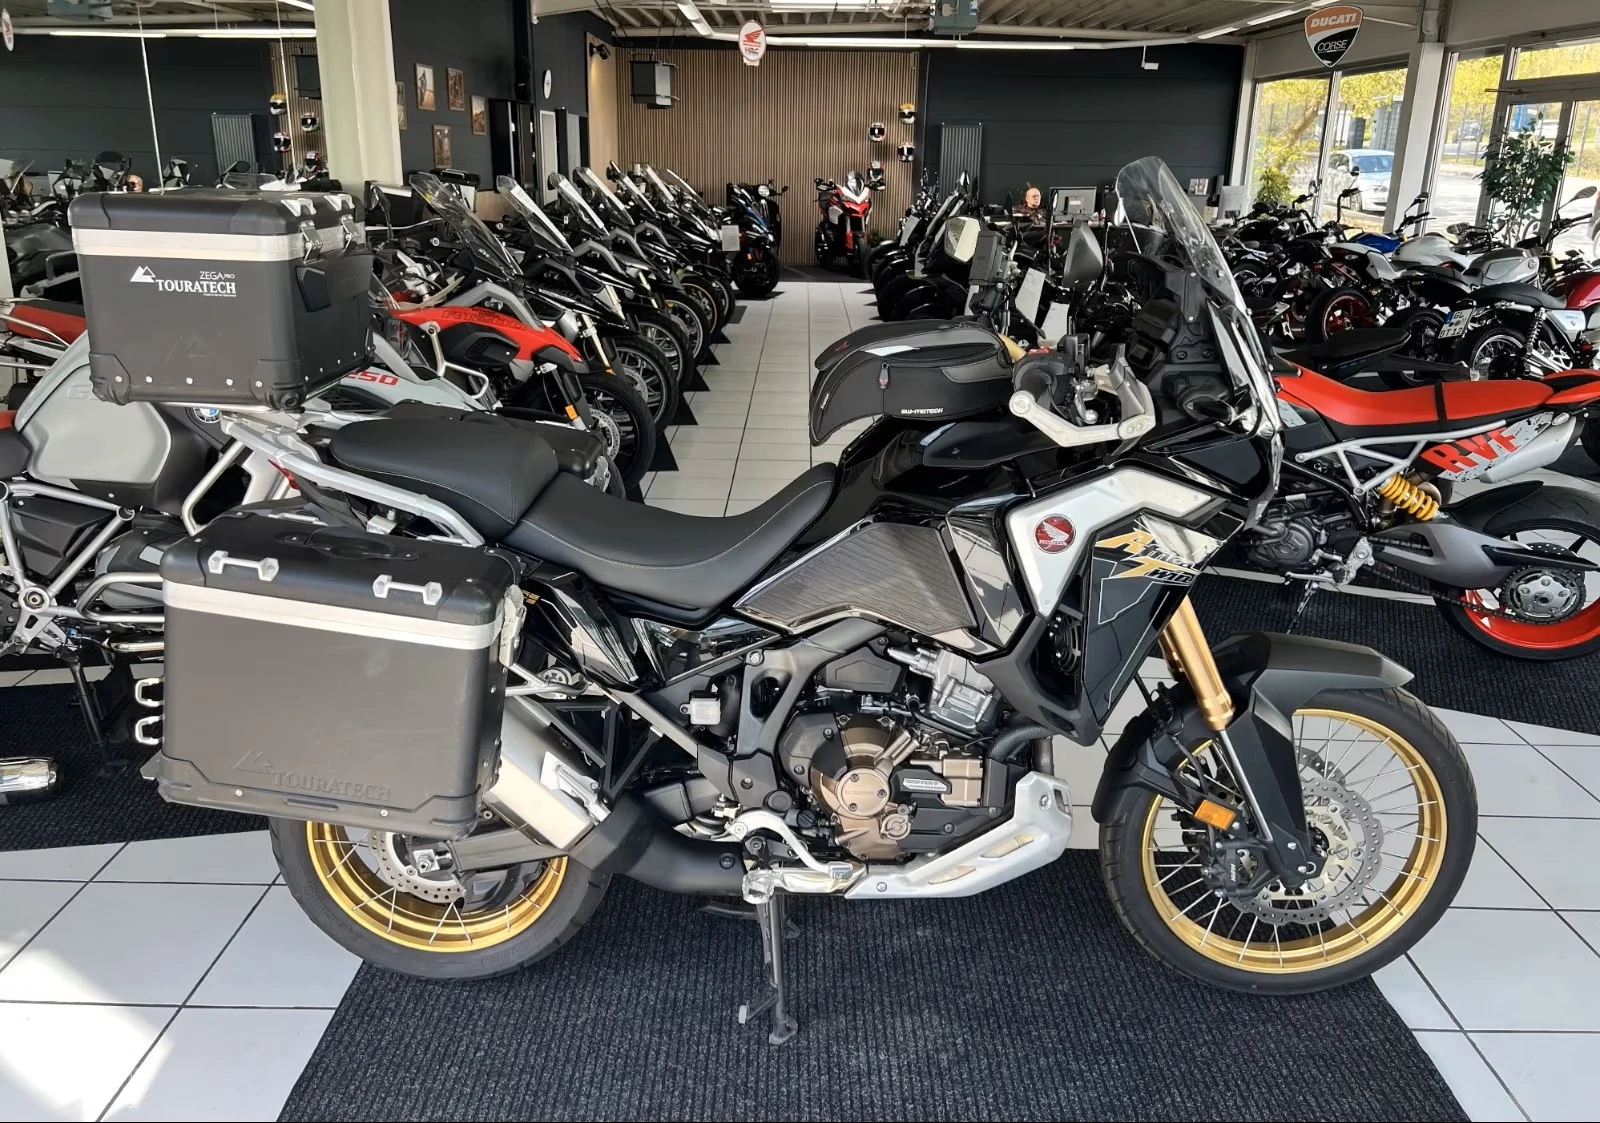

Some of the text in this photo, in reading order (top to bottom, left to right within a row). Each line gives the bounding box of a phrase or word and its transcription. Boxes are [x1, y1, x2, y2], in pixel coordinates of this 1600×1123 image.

[1311, 13, 1357, 28] DUCATI
[1317, 39, 1348, 51] CORSE
[199, 270, 224, 280] ZEGA
[156, 279, 236, 294] TOURATECH
[272, 771, 392, 801] TOURATECH
